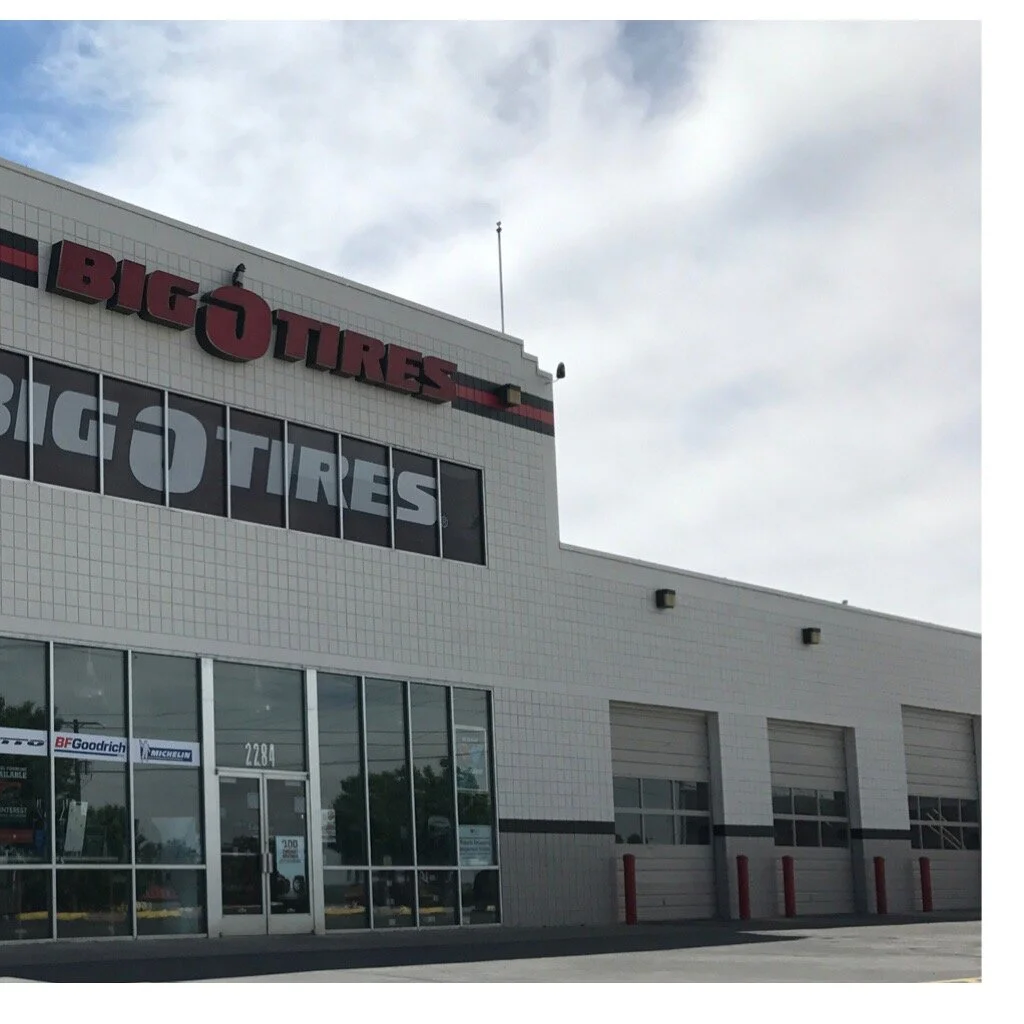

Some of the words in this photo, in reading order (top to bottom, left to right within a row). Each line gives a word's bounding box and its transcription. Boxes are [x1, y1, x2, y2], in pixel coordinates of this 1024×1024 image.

[46, 239, 200, 331] BIG
[195, 285, 273, 363] O
[271, 308, 458, 404] TIRES
[128, 405, 208, 494] O
[215, 426, 440, 528] TIRES
[55, 736, 126, 754] BFGoodrich
[149, 749, 192, 760] MICHELIN
[245, 742, 275, 767] 2284
